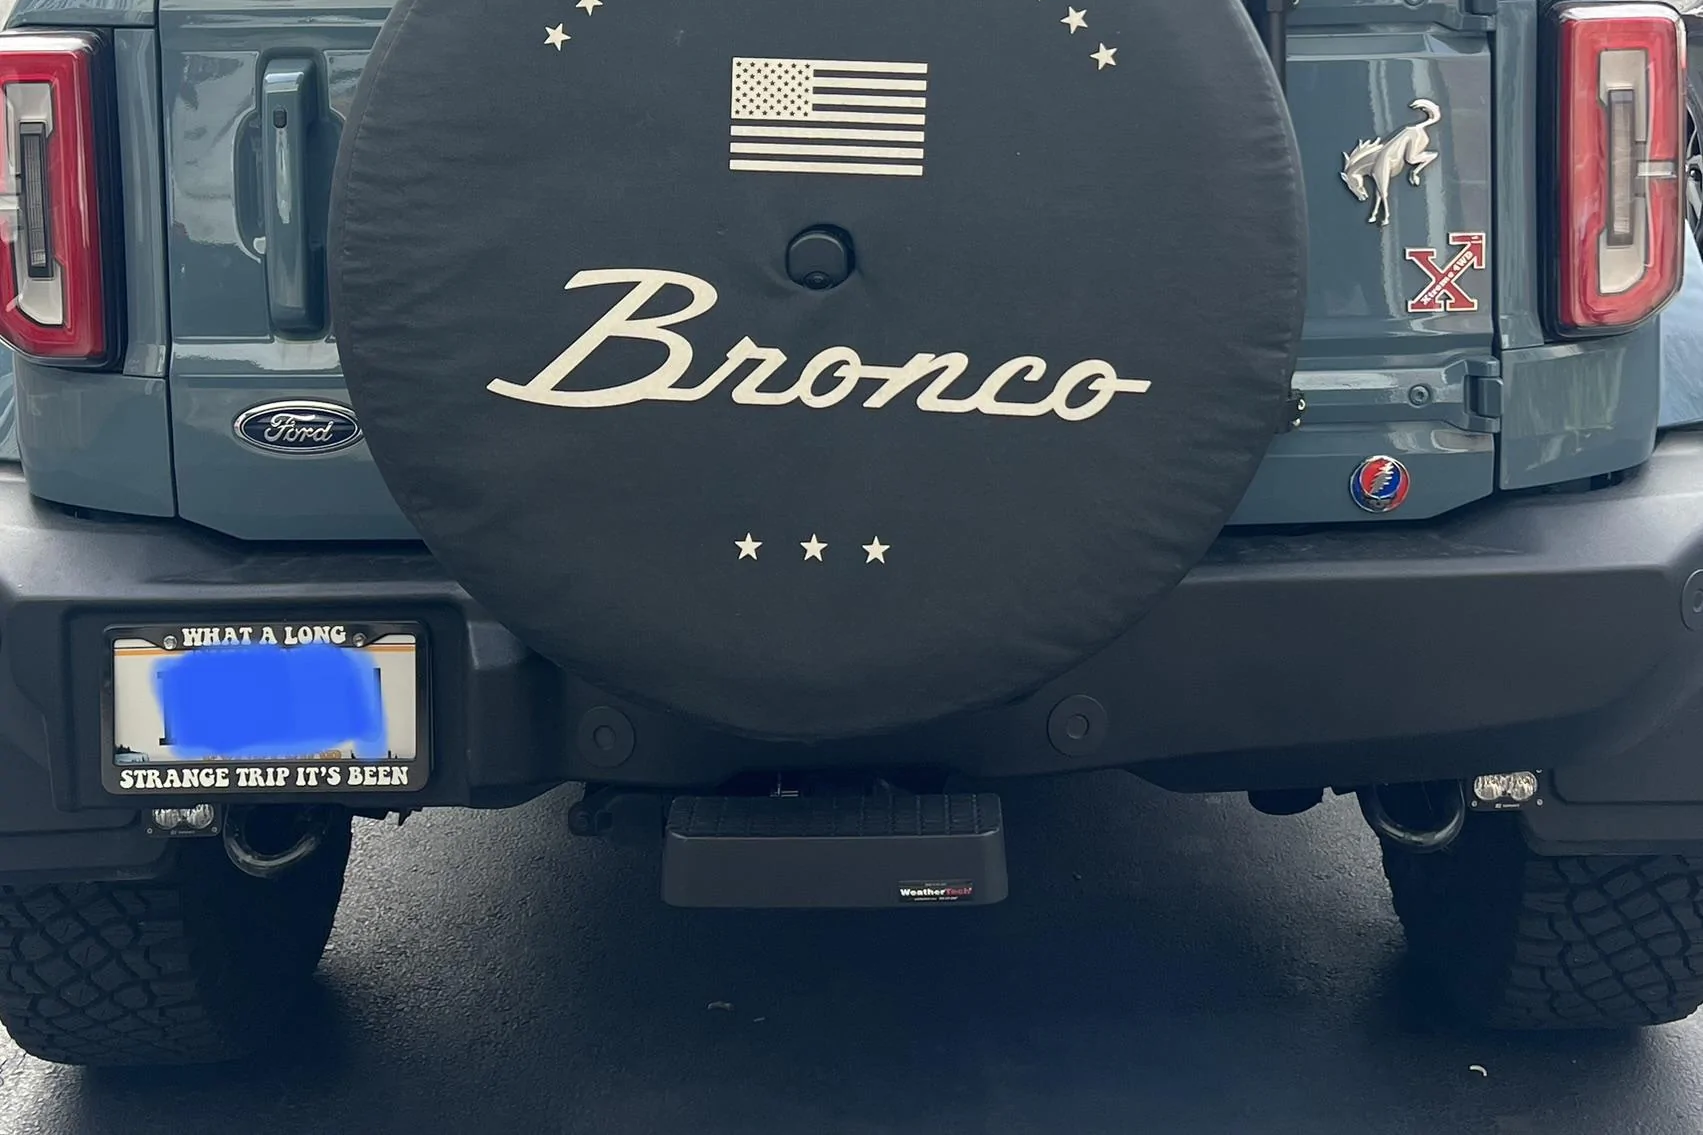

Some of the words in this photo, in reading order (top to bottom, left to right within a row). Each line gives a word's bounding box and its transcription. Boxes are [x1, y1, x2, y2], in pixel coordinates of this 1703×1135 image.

[486, 268, 1152, 421] Bronco
[263, 413, 334, 442] Ford
[181, 627, 253, 646] WHAT
[259, 626, 278, 645] A
[284, 625, 347, 645] LONG
[119, 767, 229, 788] STRANGE
[236, 767, 290, 787] TRIP
[296, 767, 342, 786] IT'S
[347, 766, 409, 786] BEEN
